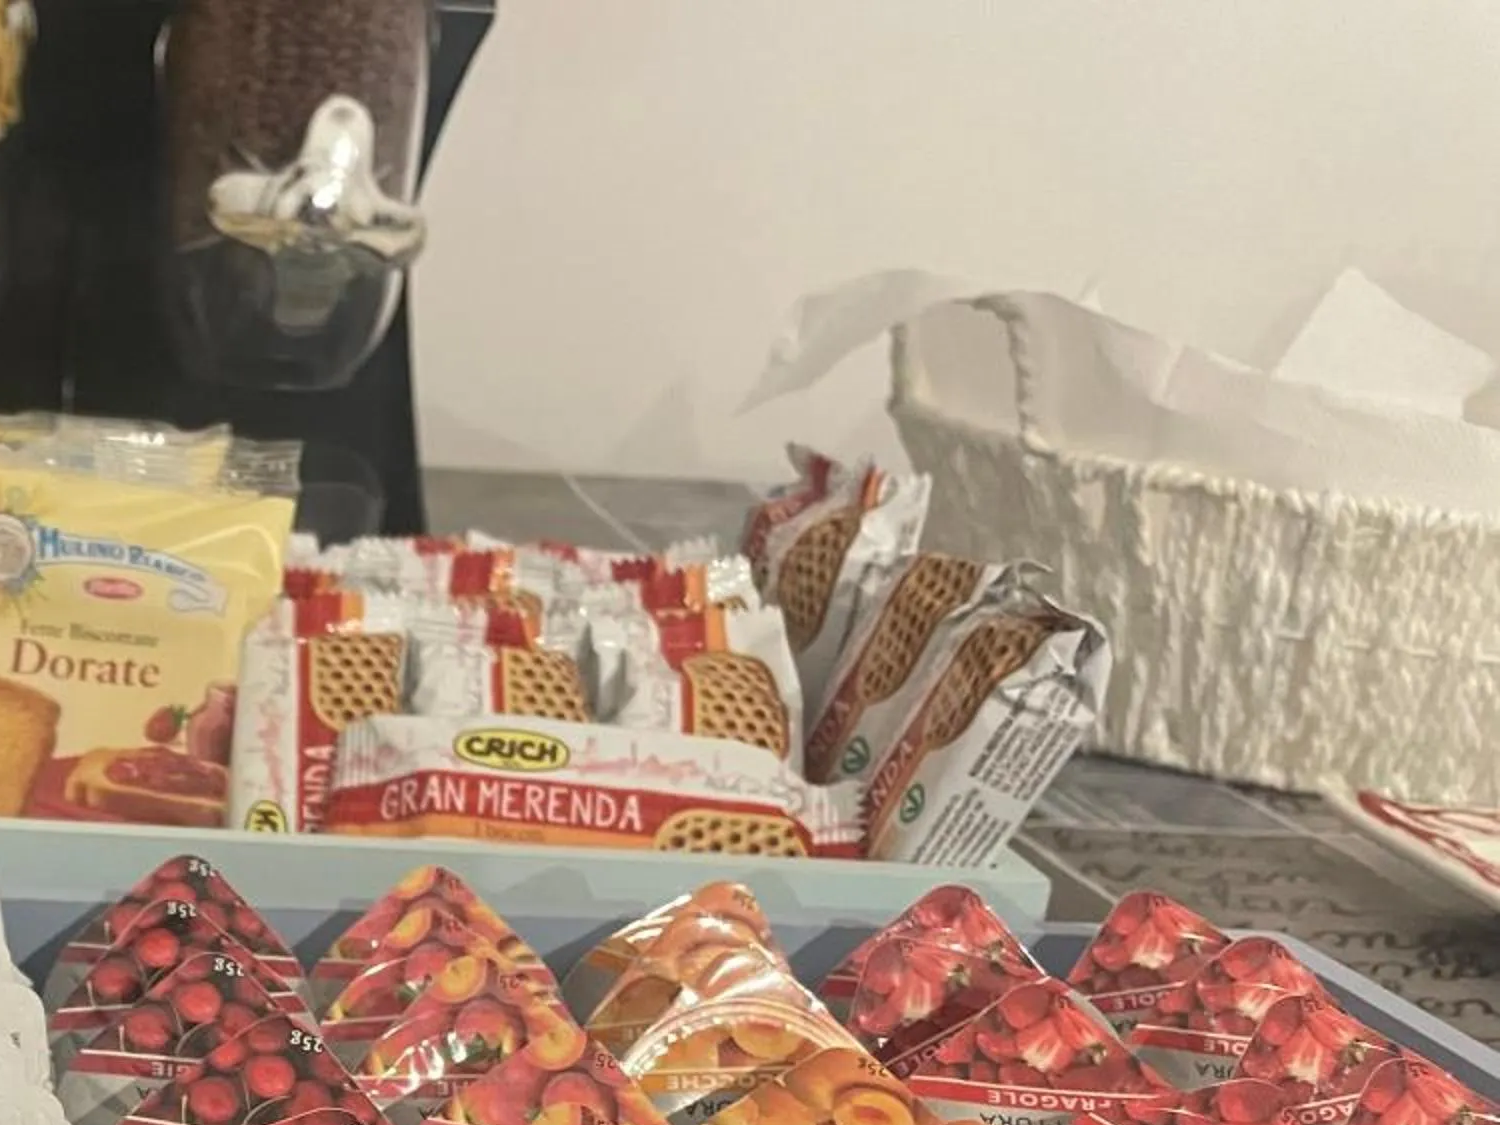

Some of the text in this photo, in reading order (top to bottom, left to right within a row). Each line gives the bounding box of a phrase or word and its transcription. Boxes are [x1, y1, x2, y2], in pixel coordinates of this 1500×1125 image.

[10, 637, 162, 689] Dorate
[462, 734, 561, 764] CRICH
[379, 774, 467, 822] GRAN
[476, 778, 644, 832] MERENDA
[290, 1028, 324, 1055] 25g
